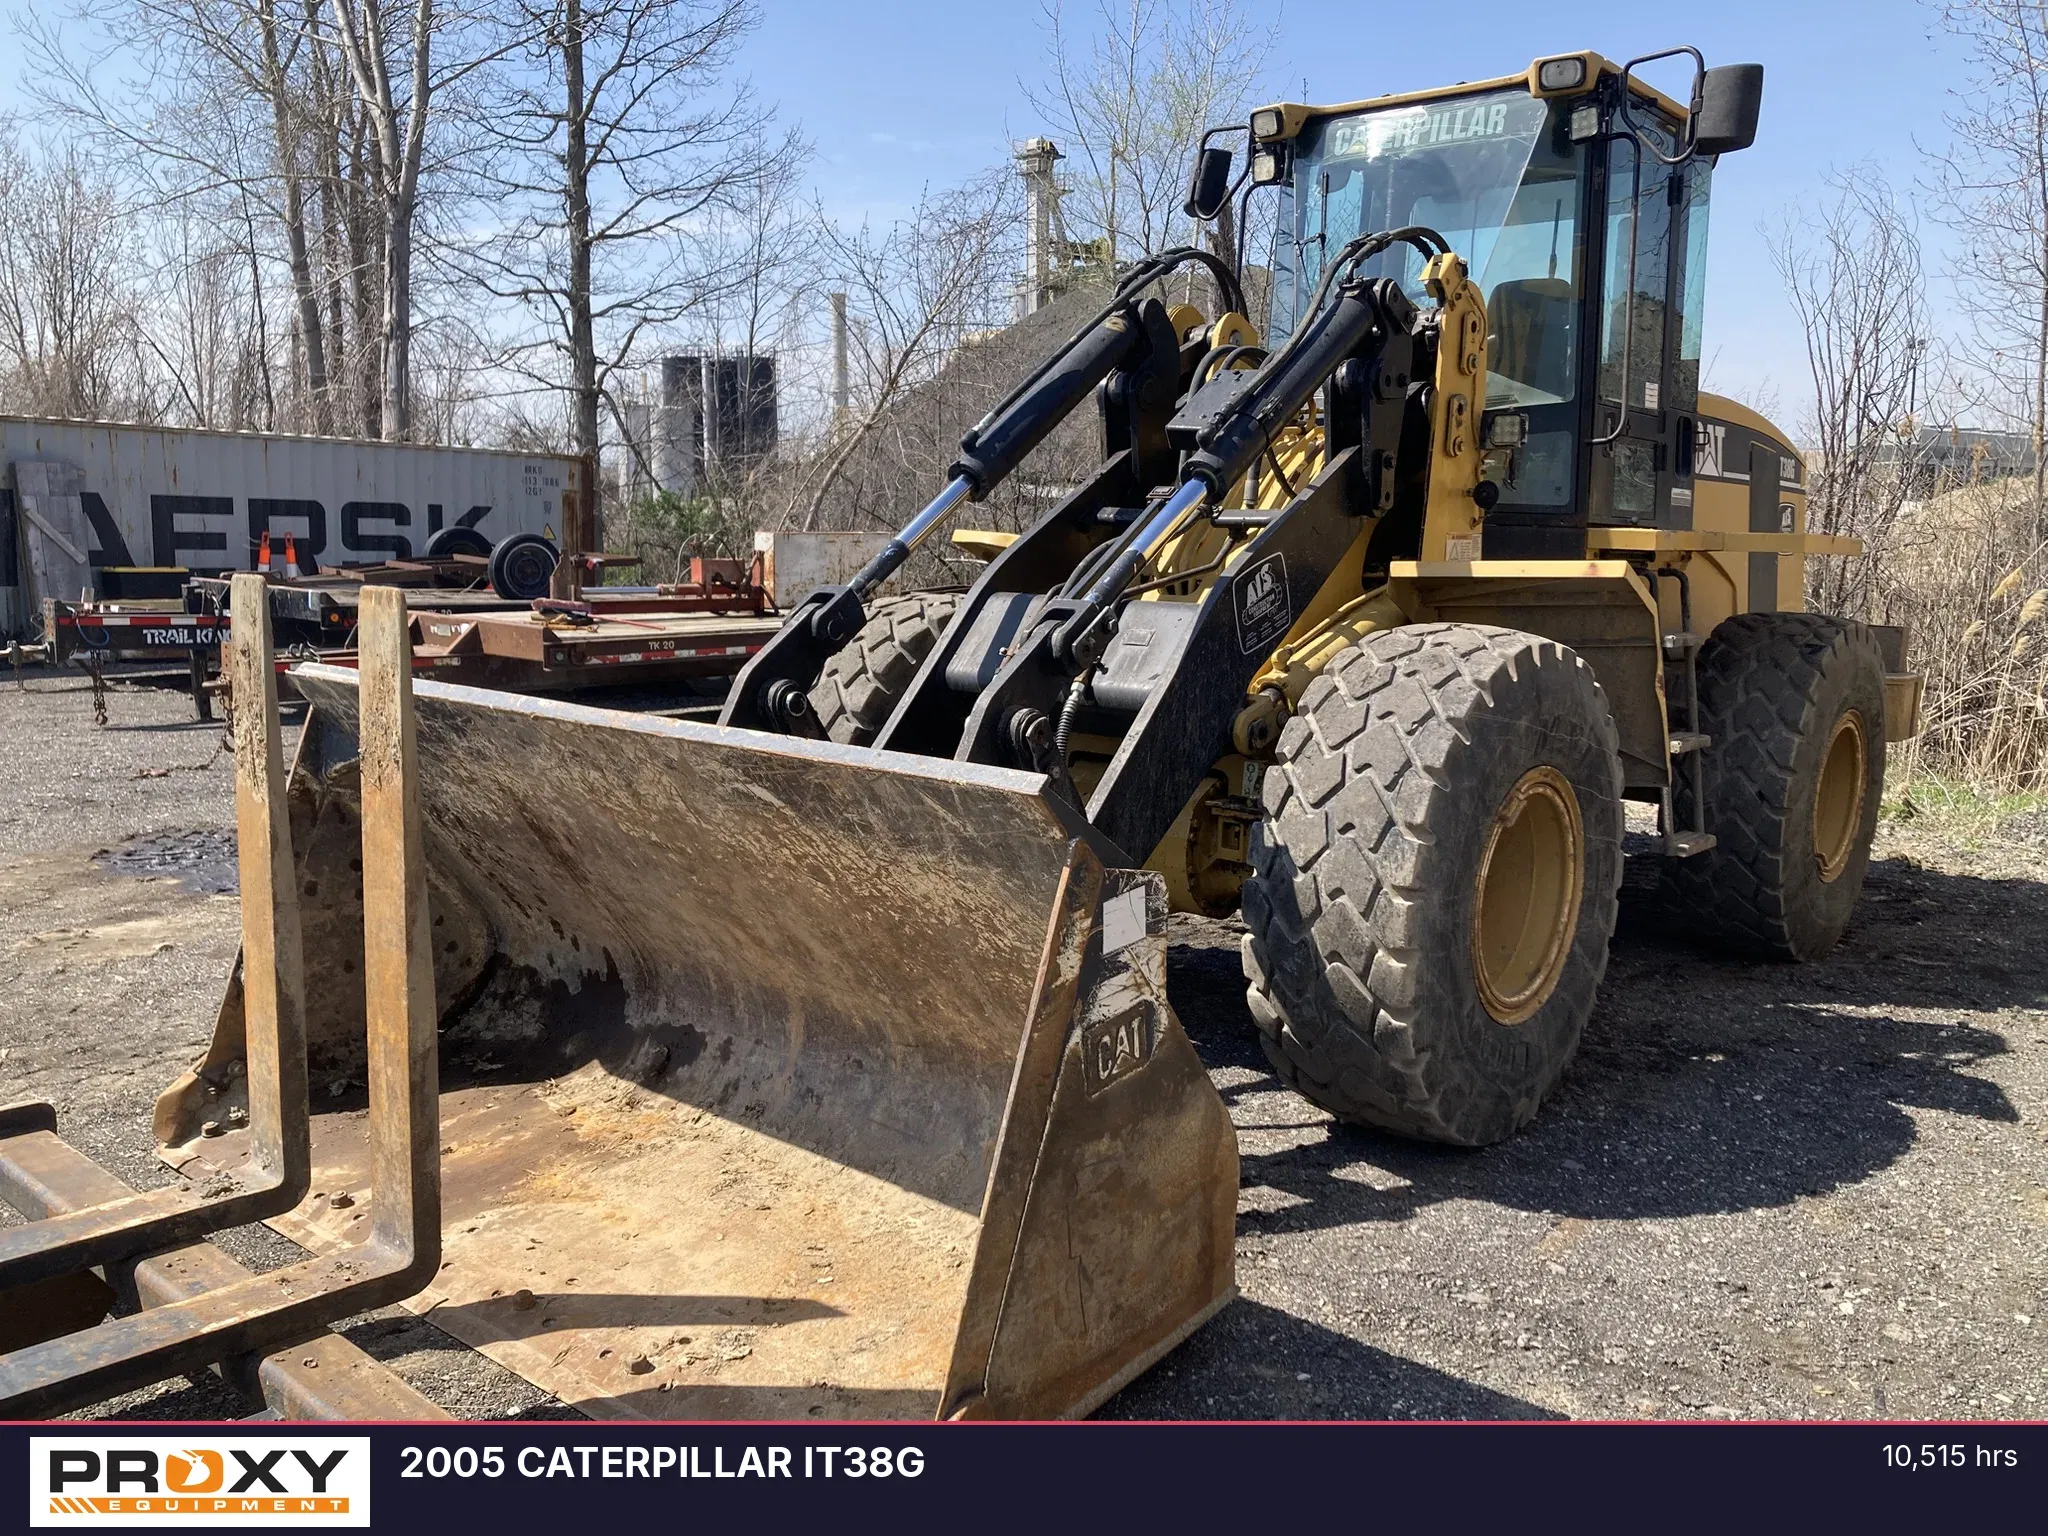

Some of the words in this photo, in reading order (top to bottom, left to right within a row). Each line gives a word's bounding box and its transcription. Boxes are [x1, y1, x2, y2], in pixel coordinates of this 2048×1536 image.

[1695, 421, 1726, 477] CAT
[648, 641, 660, 650] TK
[662, 640, 675, 649] 20
[1098, 1016, 1143, 1080] CAT
